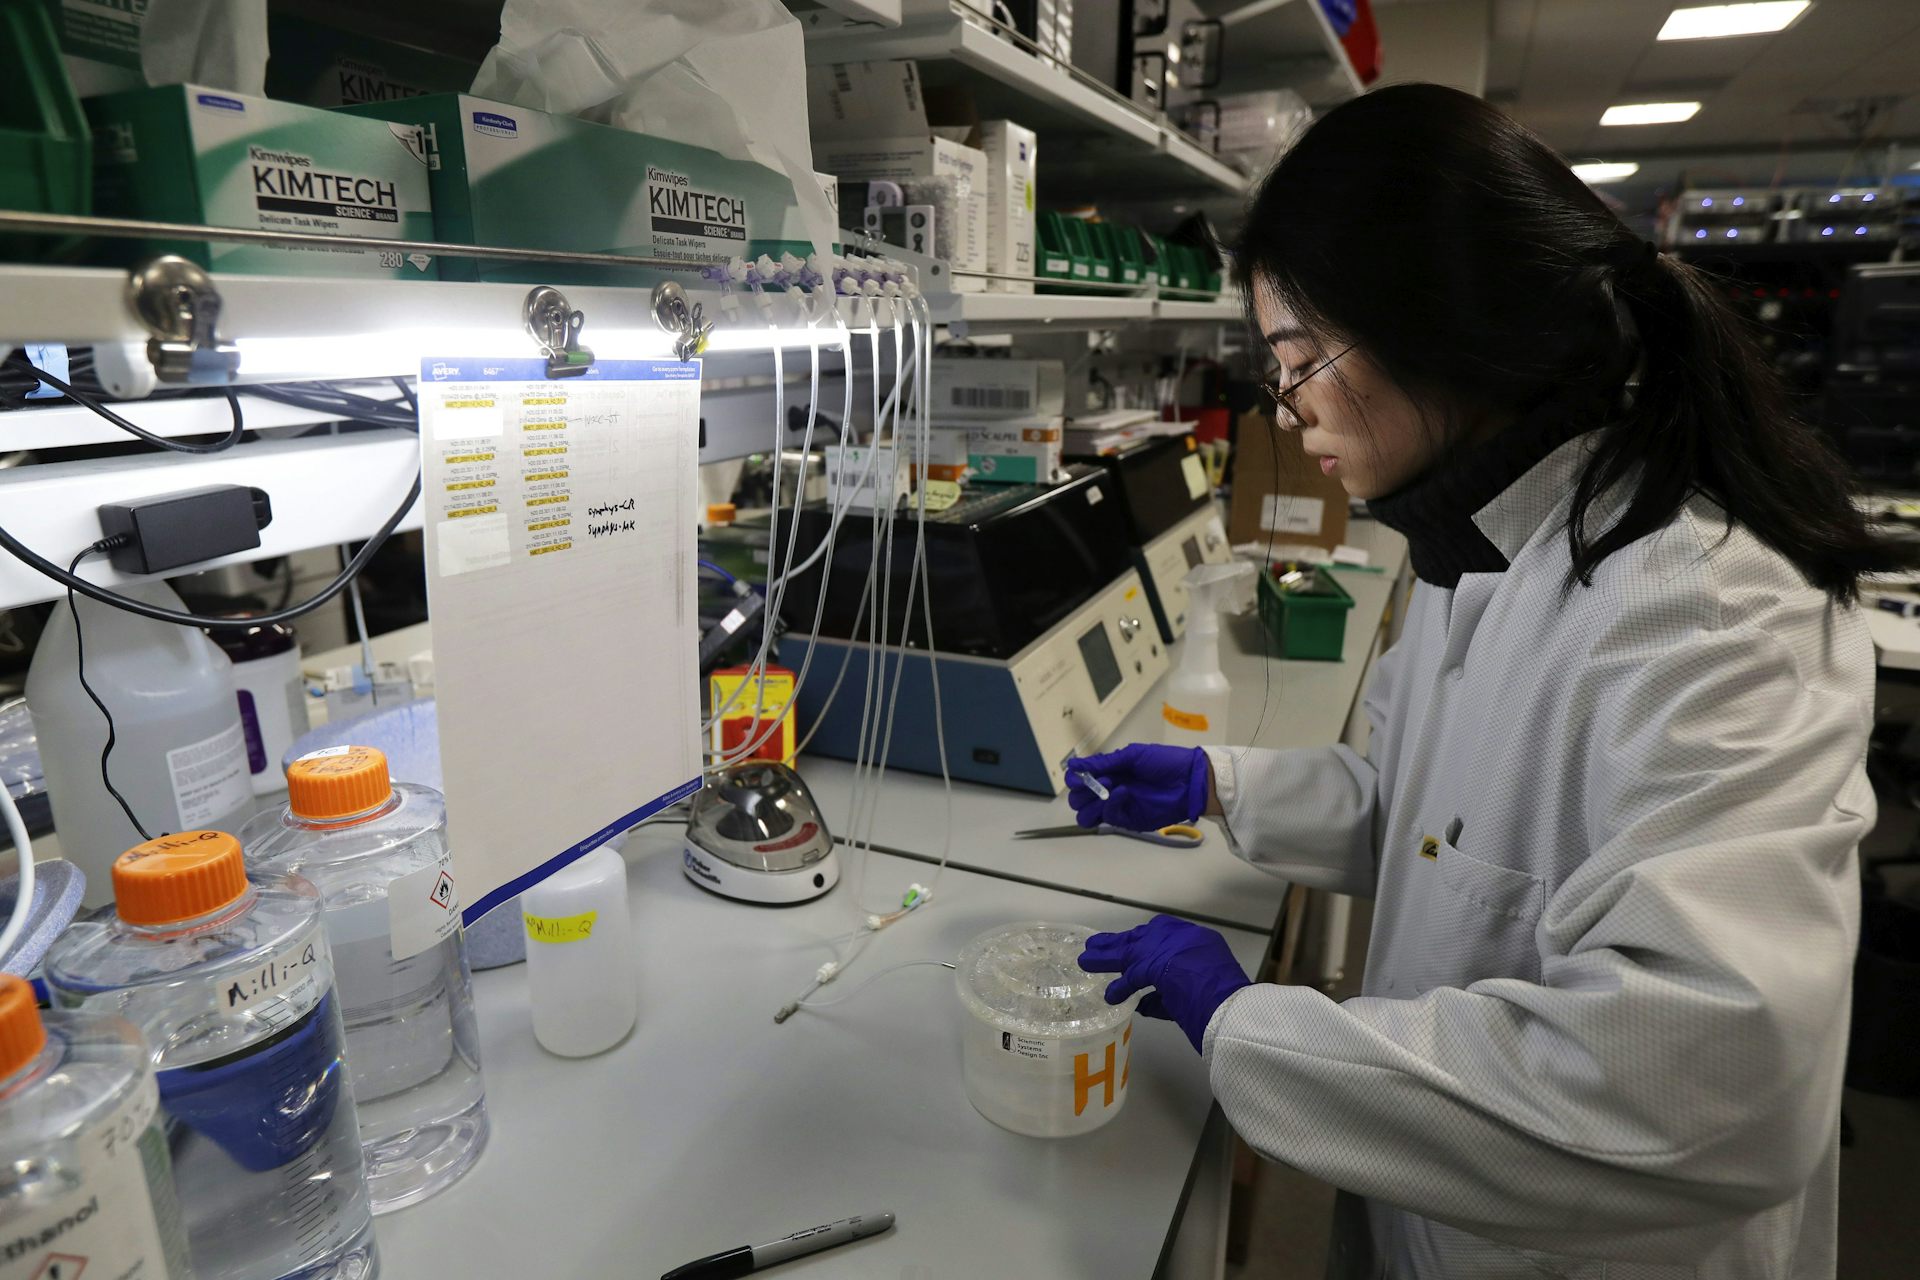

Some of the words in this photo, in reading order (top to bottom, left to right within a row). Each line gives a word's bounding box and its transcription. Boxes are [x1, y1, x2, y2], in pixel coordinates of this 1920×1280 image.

[339, 71, 430, 101] KIMT
[251, 147, 310, 168] Kimwipes
[648, 167, 688, 187] Kimwipes
[253, 165, 397, 208] KIMTECH
[335, 205, 371, 219] SCIENCE
[649, 185, 745, 225] KIMTECH
[312, 219, 339, 230] Wipers
[703, 225, 728, 238] SCIENCE
[380, 252, 404, 268] 280
[432, 367, 460, 376] AVERY
[228, 943, 316, 1007] Milli-Q
[1017, 1036, 1046, 1046] Scientific
[1017, 1043, 1042, 1052] Systems
[1017, 1049, 1038, 1058] Design
[0, 1195, 99, 1261] thanol
